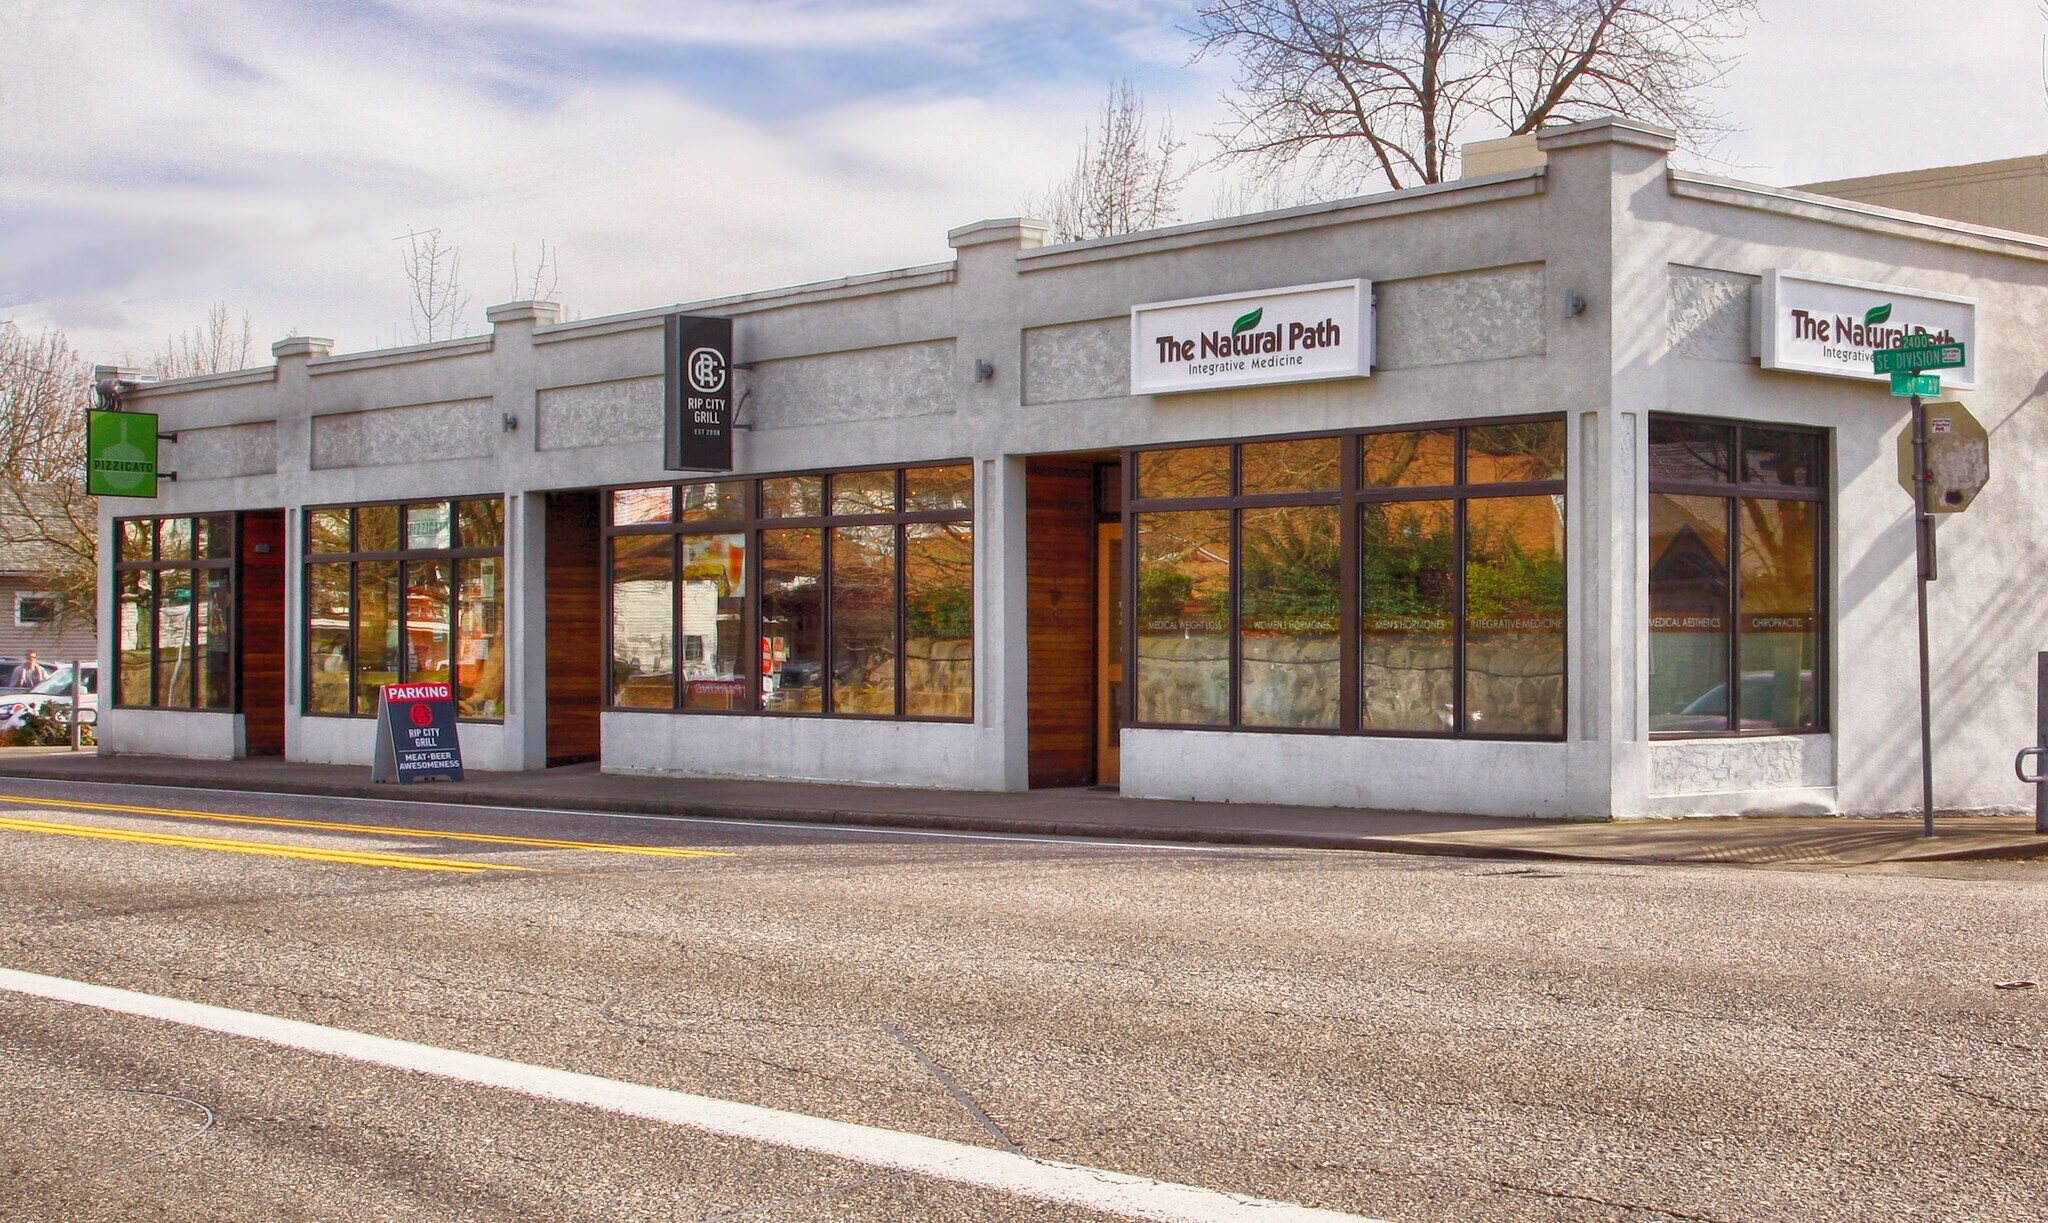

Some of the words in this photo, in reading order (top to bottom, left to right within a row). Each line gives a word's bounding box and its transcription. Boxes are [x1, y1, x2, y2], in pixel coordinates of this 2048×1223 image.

[1791, 309, 1830, 342] The
[1835, 315, 1909, 350] Natural
[1156, 335, 1196, 363] The
[1201, 323, 1283, 359] Natural
[1289, 317, 1341, 351] Path
[1903, 335, 1928, 349] 2400
[1823, 346, 1874, 363] Integrative
[1876, 354, 1890, 370] SE
[1896, 350, 1940, 368] DIVISION
[1188, 361, 1245, 376] Integrative
[1251, 355, 1303, 369] Medicine
[688, 398, 703, 410] RIP
[705, 399, 726, 411] CITY
[694, 411, 720, 424] GRILL
[94, 460, 153, 473] PIZZICATO
[1149, 620, 1178, 630] MEDICAL
[1179, 619, 1204, 630] WEIGHT
[1400, 619, 1446, 630] HORMONES
[1471, 618, 1520, 629] INTEGRATIVE
[1522, 618, 1562, 629] MEDICINE
[1649, 617, 1681, 628] MEDICAL
[1682, 617, 1721, 628] AESTHETICS
[1752, 617, 1803, 628] CHIROPRACTIC
[388, 686, 448, 700] PARKING
[408, 728, 421, 738] RIP
[423, 728, 440, 737] CITY
[415, 737, 437, 747] GRILL
[399, 760, 460, 770] AWESOMENESS
